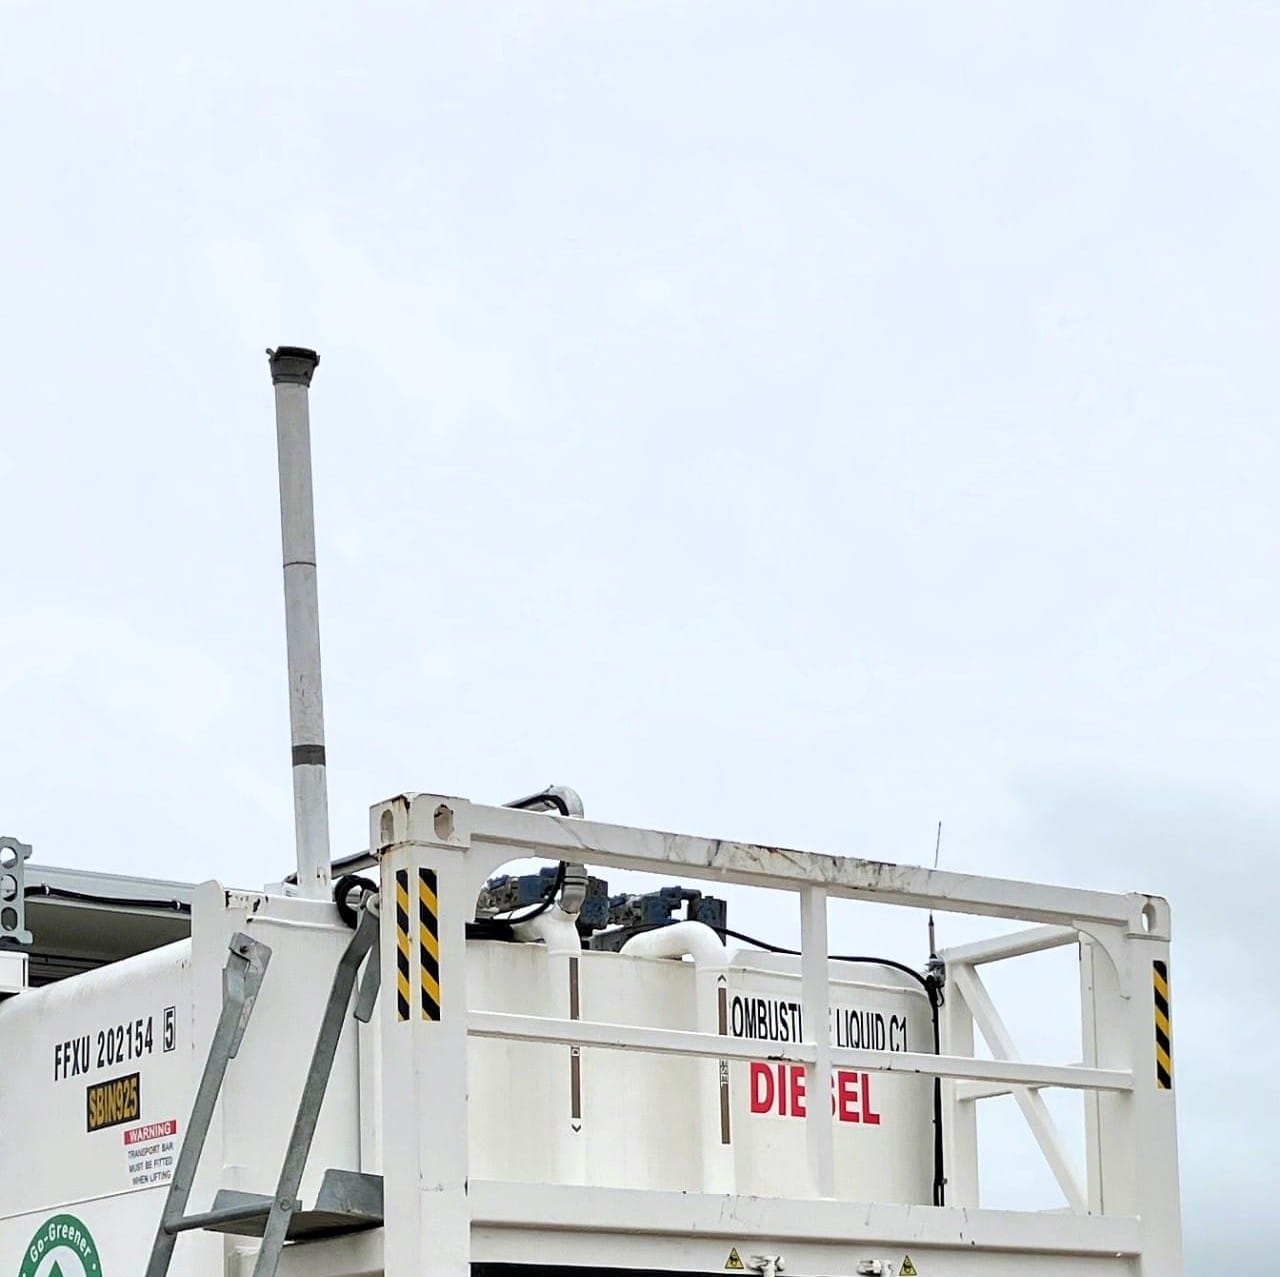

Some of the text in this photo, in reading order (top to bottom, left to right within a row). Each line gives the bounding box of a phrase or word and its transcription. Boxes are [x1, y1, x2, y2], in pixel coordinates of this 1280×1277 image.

[730, 996, 907, 1052] OMBUSTI LIQUID C1
[55, 1009, 174, 1082] FFXU 202154 5
[89, 1078, 137, 1127] SBIN925
[750, 1061, 880, 1125] DIEEL
[128, 1142, 173, 1158] TRANSPORT BAR
[129, 1122, 171, 1142] WARNING
[129, 1156, 172, 1172] MUST BE FITTED
[132, 1170, 171, 1185] WHEN LIFTING
[30, 1223, 91, 1263] Go-Greener
